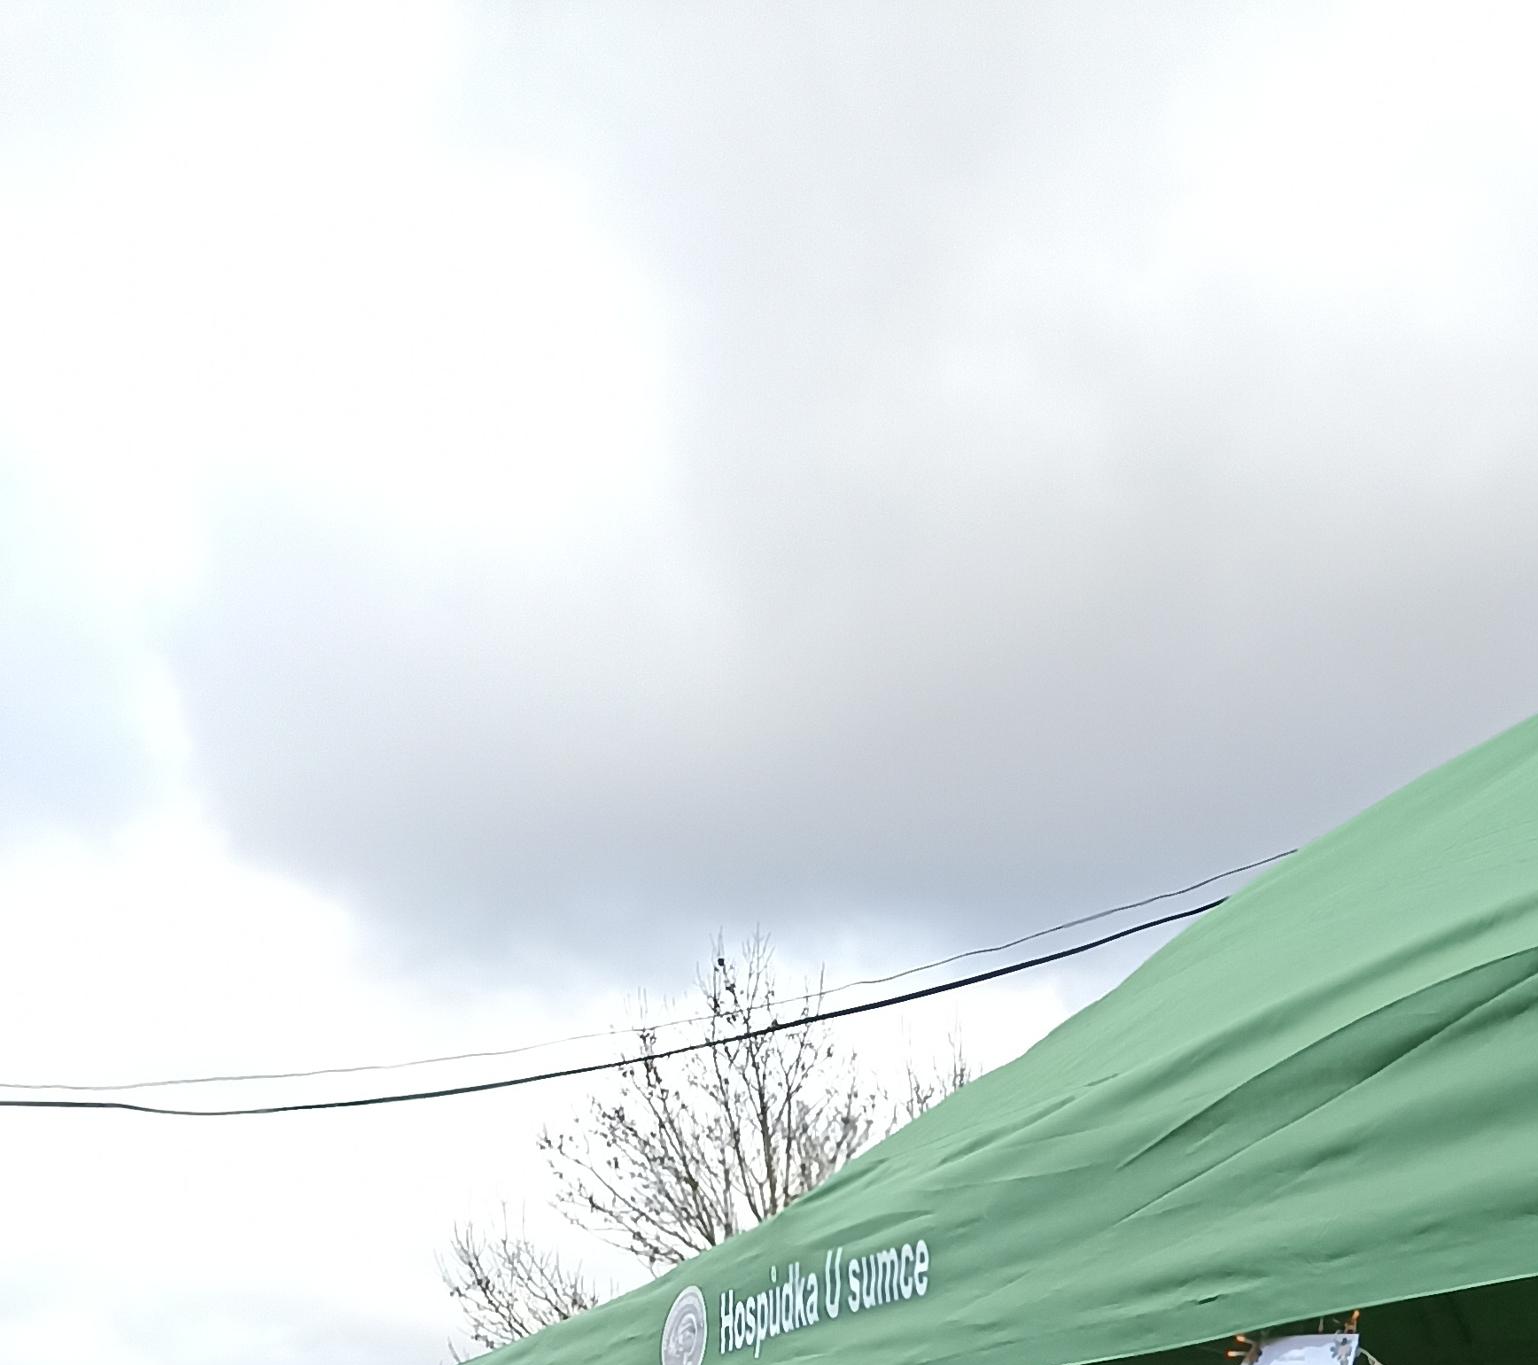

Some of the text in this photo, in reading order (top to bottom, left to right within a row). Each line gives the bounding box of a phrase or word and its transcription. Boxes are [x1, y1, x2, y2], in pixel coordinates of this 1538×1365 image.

[719, 1239, 930, 1359] Hospůdka U sumce
